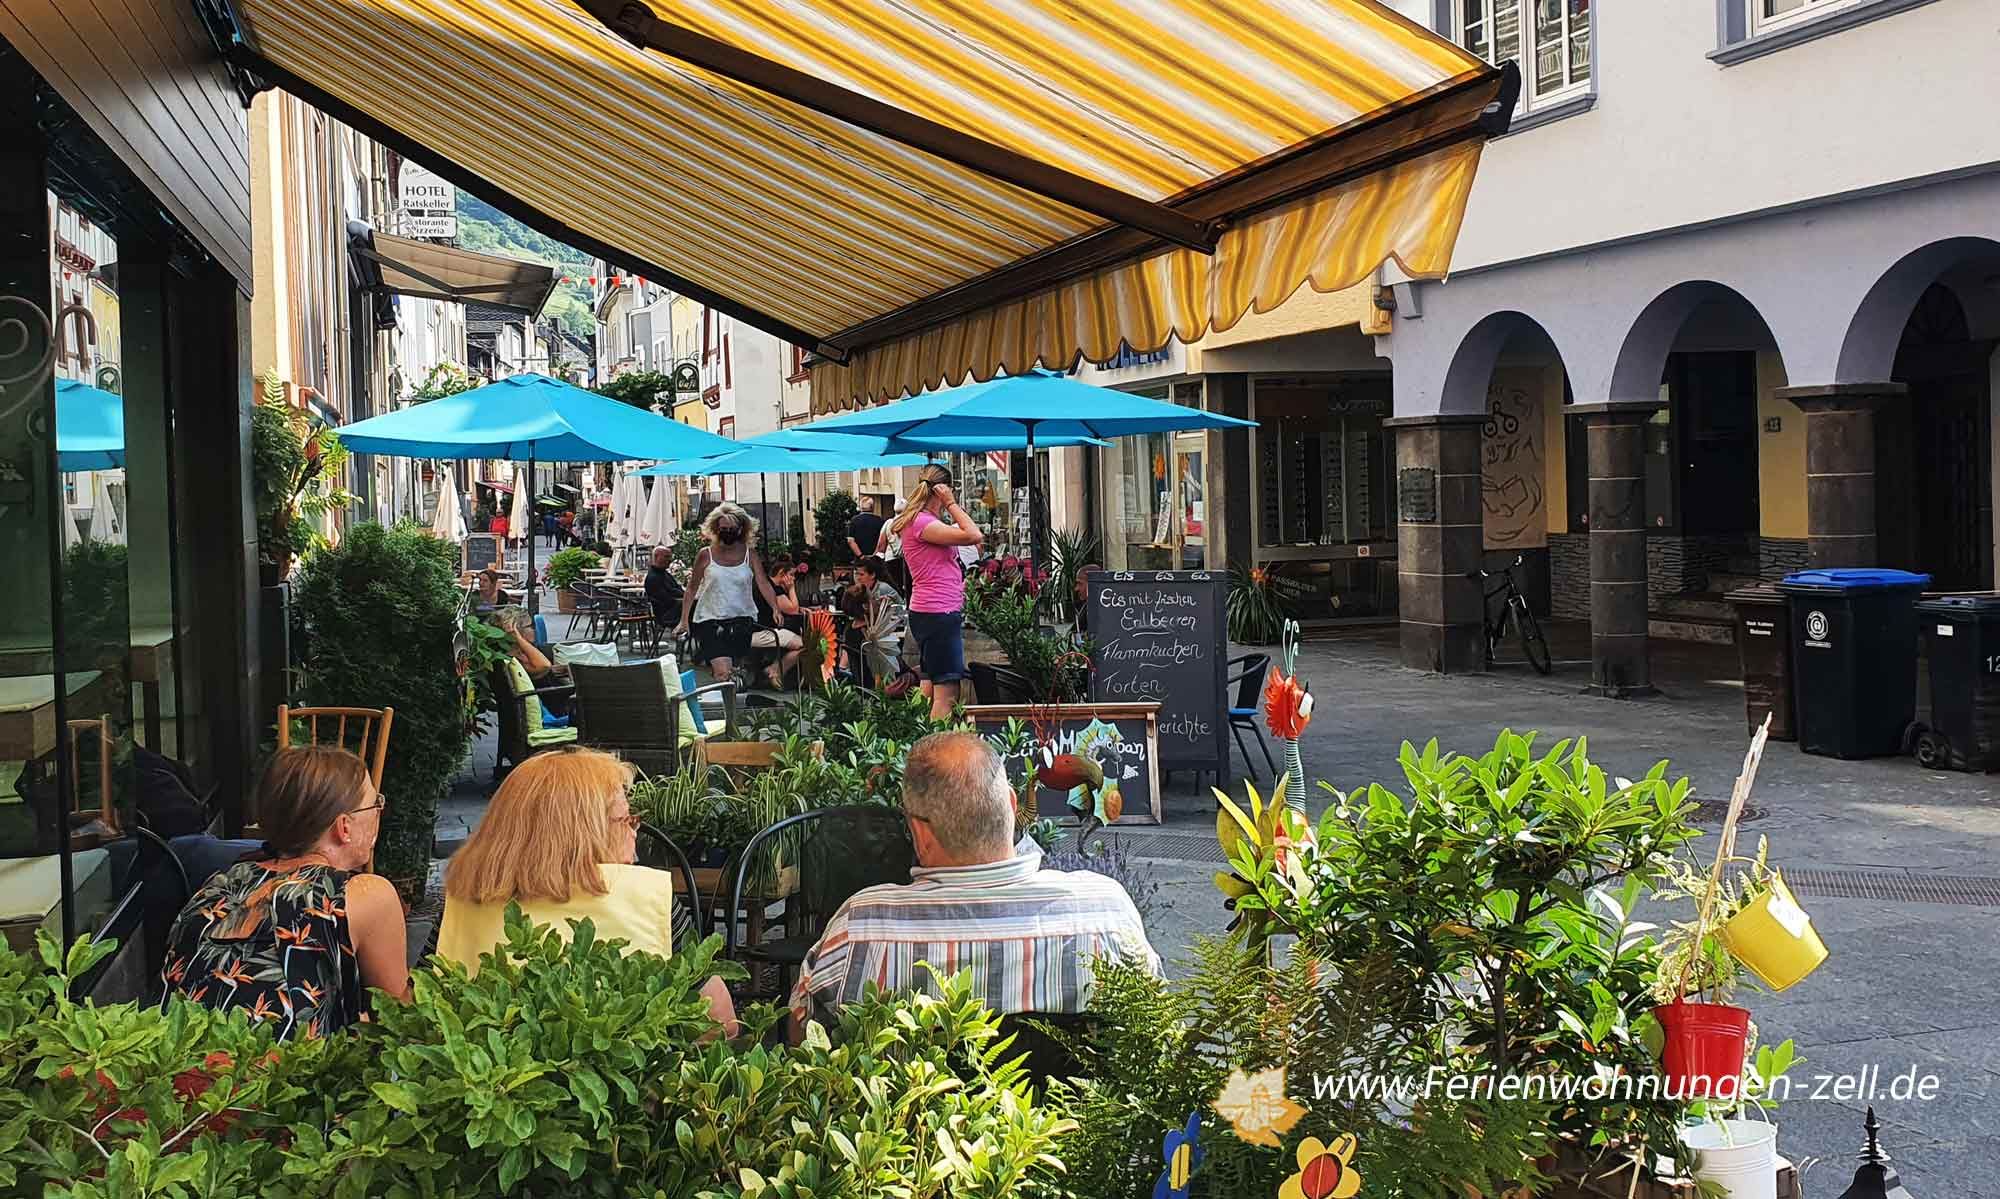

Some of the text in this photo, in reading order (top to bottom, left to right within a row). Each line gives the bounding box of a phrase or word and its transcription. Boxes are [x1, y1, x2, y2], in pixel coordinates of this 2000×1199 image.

[405, 185, 447, 197] HOTEL
[403, 199, 450, 209] Ratskeller
[1113, 571, 1210, 581] Eis Eis Eis
[1100, 588, 1126, 607] Eis
[1128, 592, 1151, 605] mit
[1103, 638, 1204, 664] Flammkuchen
[1103, 671, 1163, 694] Torten
[1159, 713, 1212, 742] erichte
